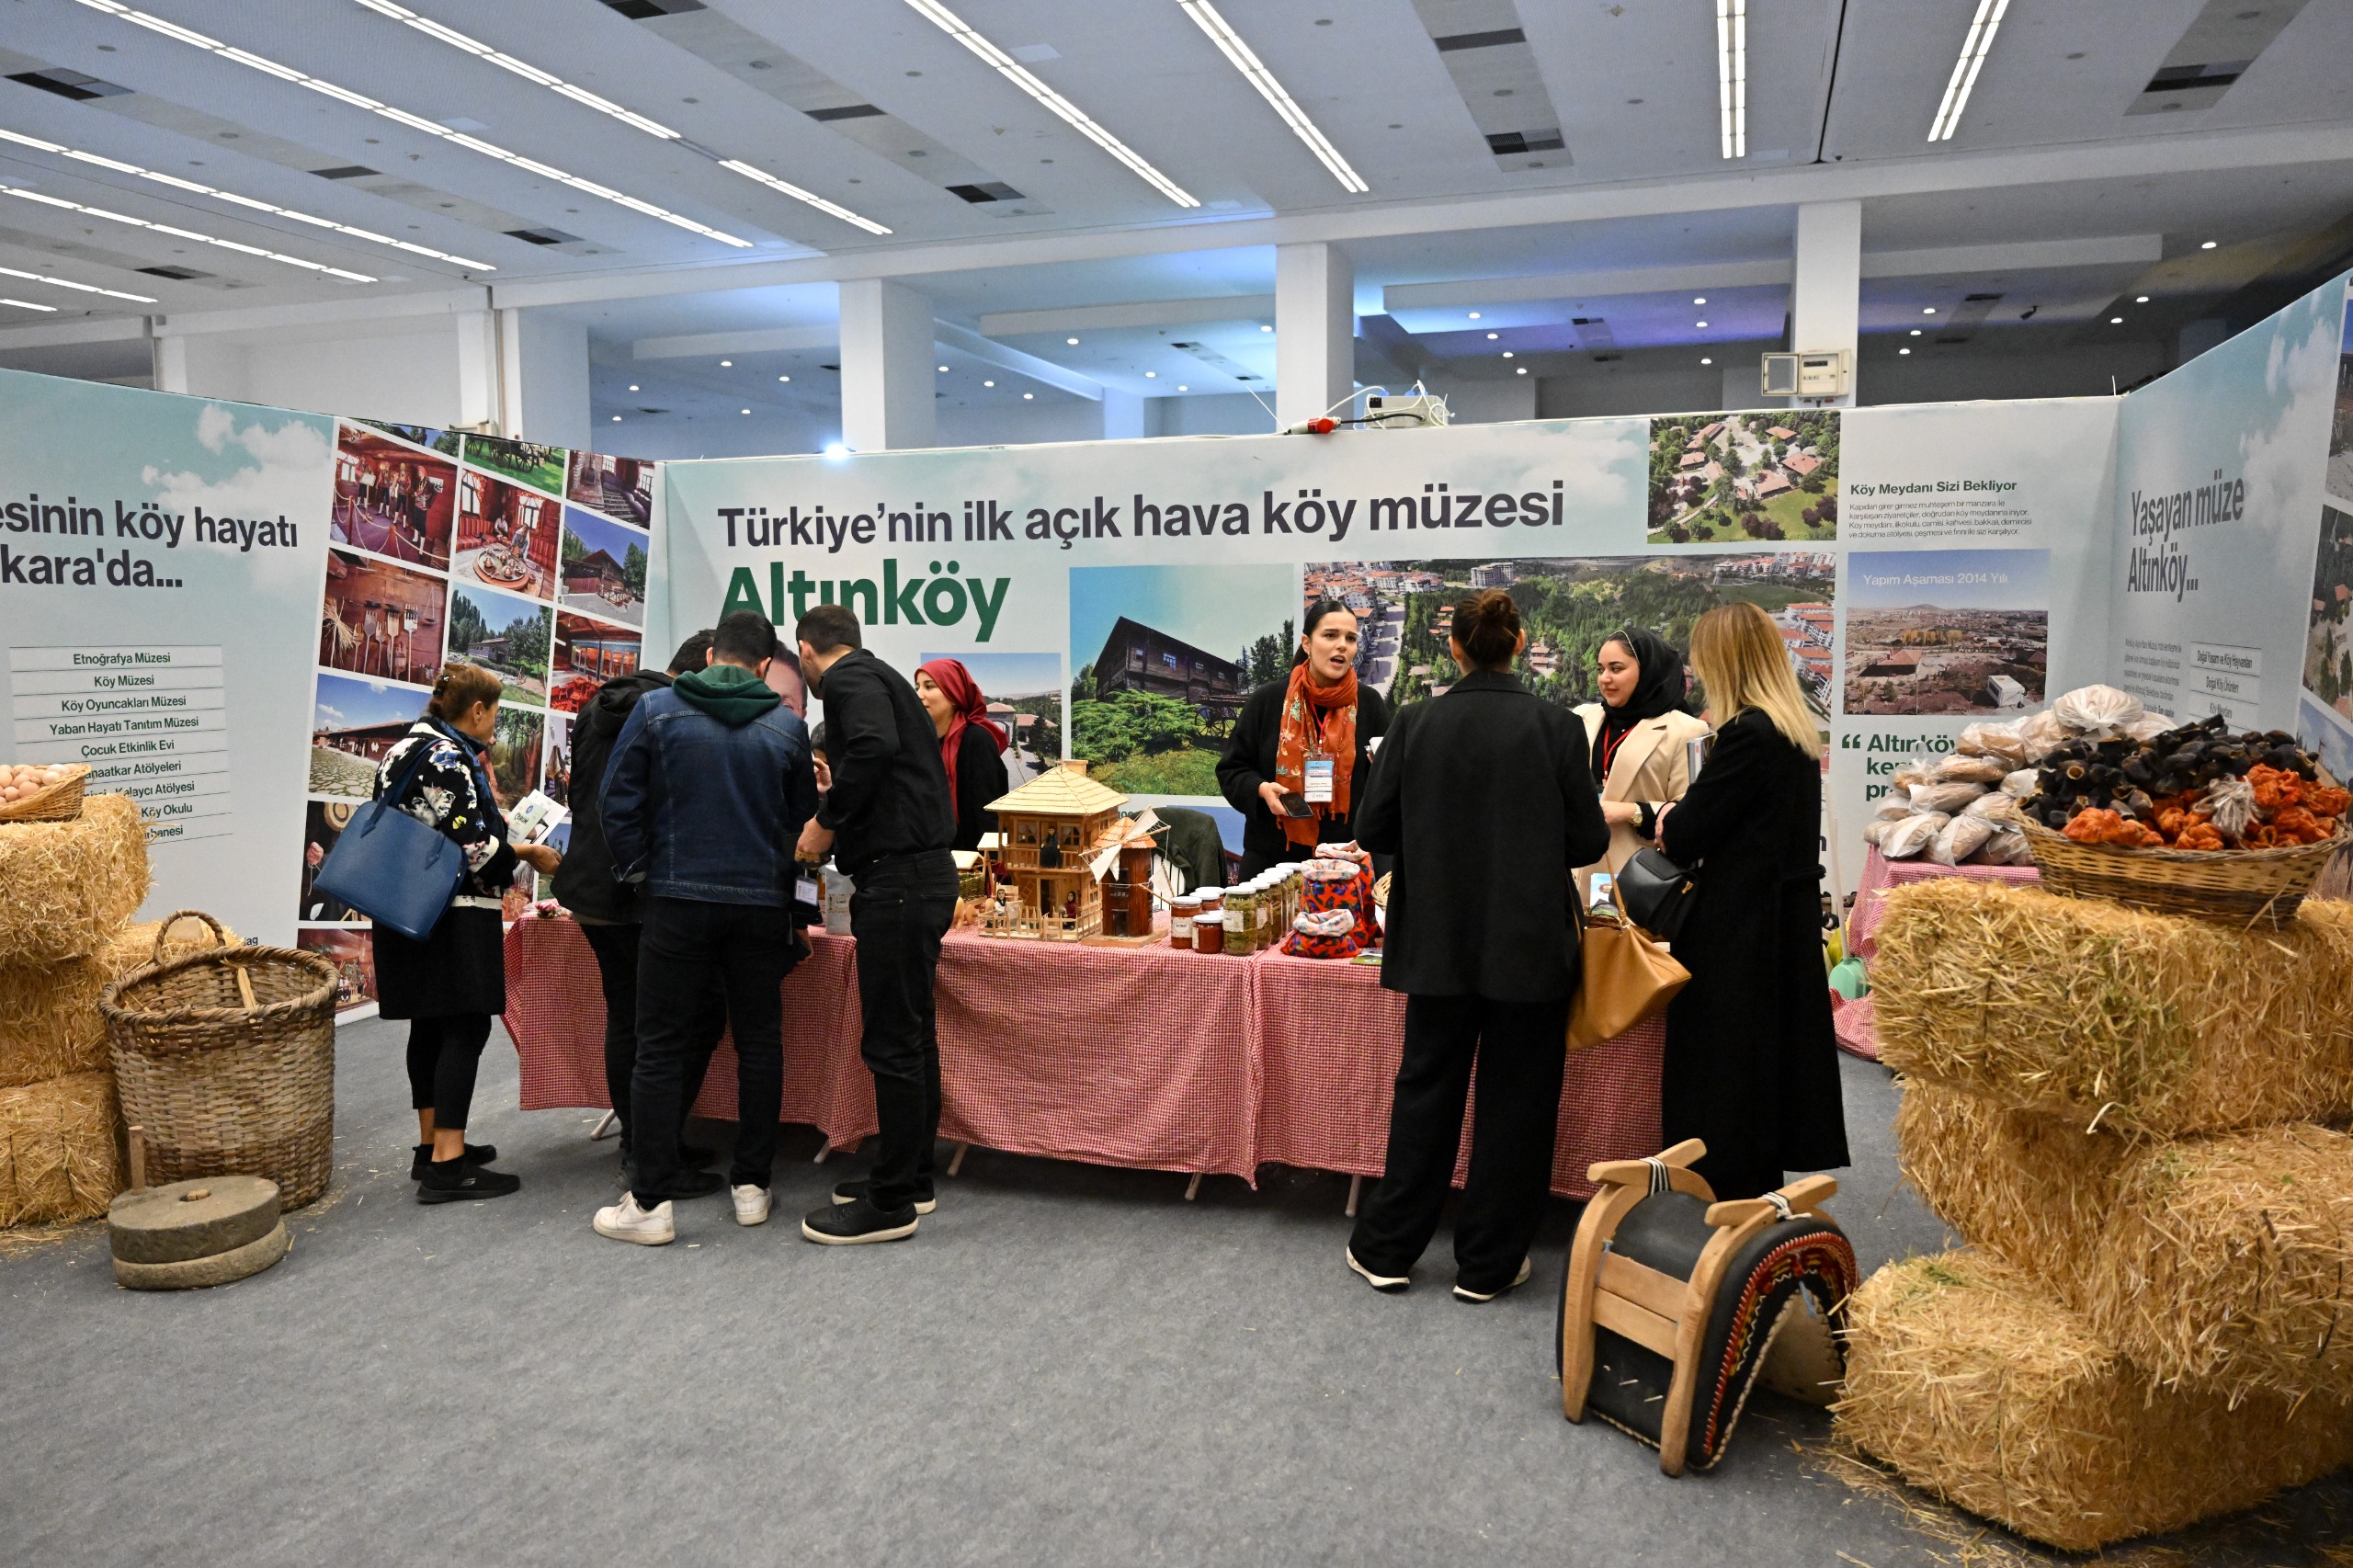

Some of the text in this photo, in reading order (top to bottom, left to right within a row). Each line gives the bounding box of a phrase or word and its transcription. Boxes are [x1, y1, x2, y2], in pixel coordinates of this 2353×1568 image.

[1850, 479, 2018, 496] Köy Meydanı Sizi Bekliyor
[964, 499, 1015, 541] ilk
[1025, 496, 1122, 550] açık
[1133, 494, 1250, 536] hava
[1264, 488, 1357, 542] köy
[1370, 480, 1563, 530] müzesi
[2131, 468, 2244, 546] Yaşayan müze
[0, 494, 298, 552] sinin köy hayatı
[1863, 572, 2008, 586] Yapım Aşaması 2014 Yılı
[2127, 541, 2199, 603] Altınköy...
[716, 558, 1011, 642] Altınköy
[73, 652, 171, 666] Etnoğrafya Müzesi
[94, 675, 154, 688] Köy Müzesi
[62, 695, 187, 712] Köy Oyuncakları Müzesi
[50, 716, 199, 735] Yaban Hayatı Tanıtım Müzesi
[81, 739, 175, 758] Çocuk Etkinlik Evi
[134, 760, 182, 775] Atölyeleri
[154, 780, 195, 795] Atölyesi
[141, 802, 193, 818] Köy Okulu
